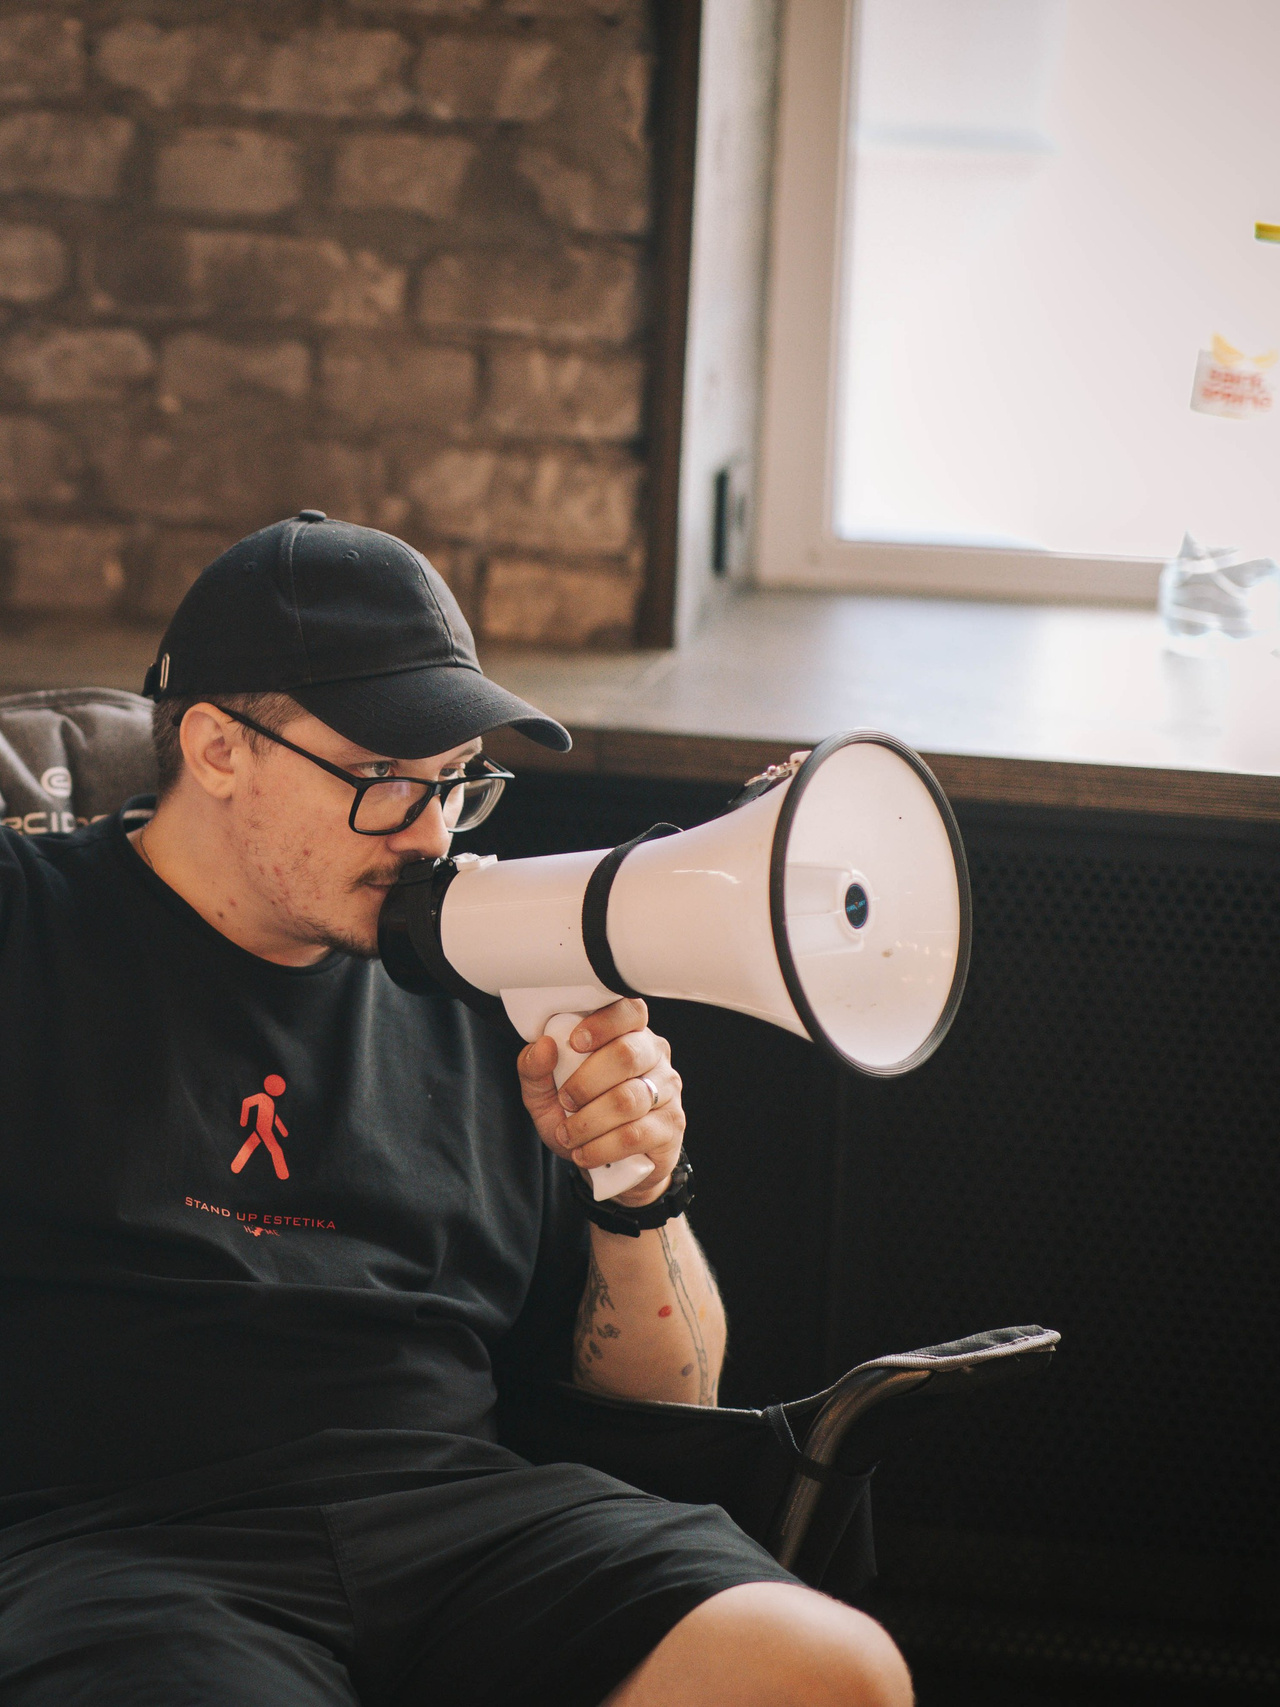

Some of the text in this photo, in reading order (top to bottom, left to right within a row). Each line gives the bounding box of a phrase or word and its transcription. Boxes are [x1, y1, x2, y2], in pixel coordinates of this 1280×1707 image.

[185, 1196, 336, 1230] STAND UP ESTETIKA
